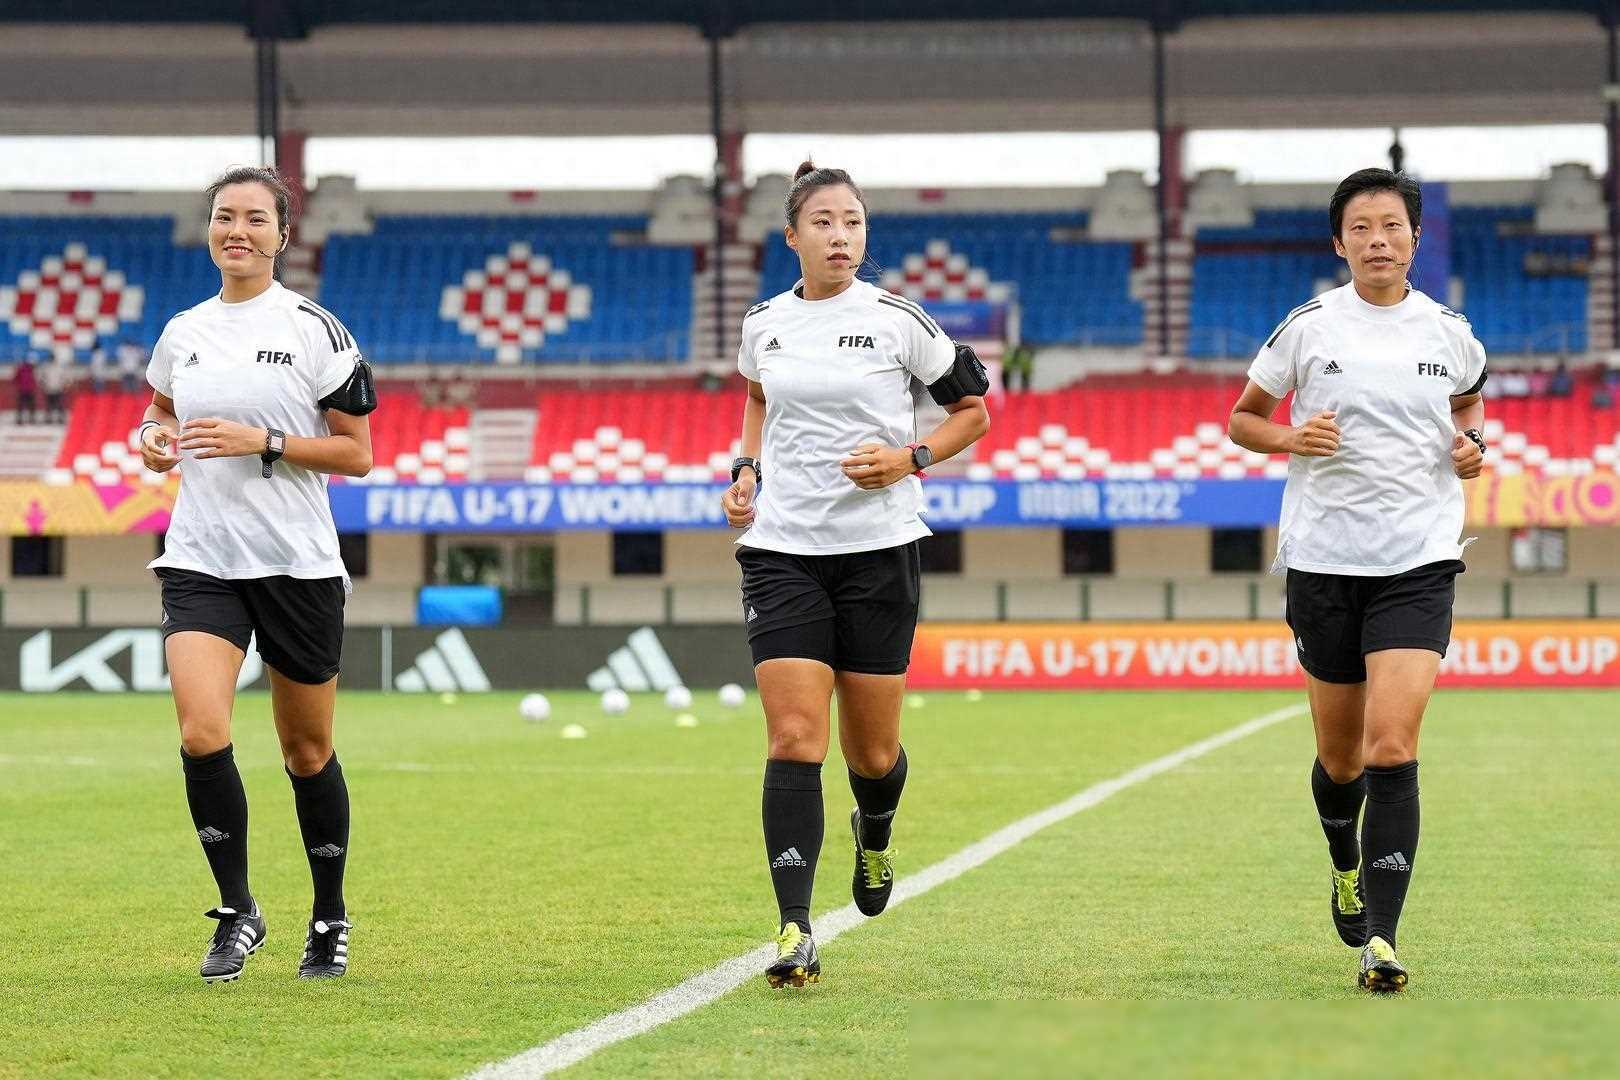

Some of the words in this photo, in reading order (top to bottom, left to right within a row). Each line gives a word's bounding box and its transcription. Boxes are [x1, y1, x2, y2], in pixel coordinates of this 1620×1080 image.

[838, 335, 875, 349] FIFA
[256, 350, 293, 366] FIFA
[1418, 362, 1448, 377] FIFA
[366, 487, 459, 525] FIFA
[462, 486, 552, 524] U-17
[943, 638, 1035, 677] FIFA
[1042, 638, 1138, 677] U-17
[1530, 635, 1618, 676] CUP
[772, 858, 807, 868] adidas
[1372, 861, 1410, 871] adidas
